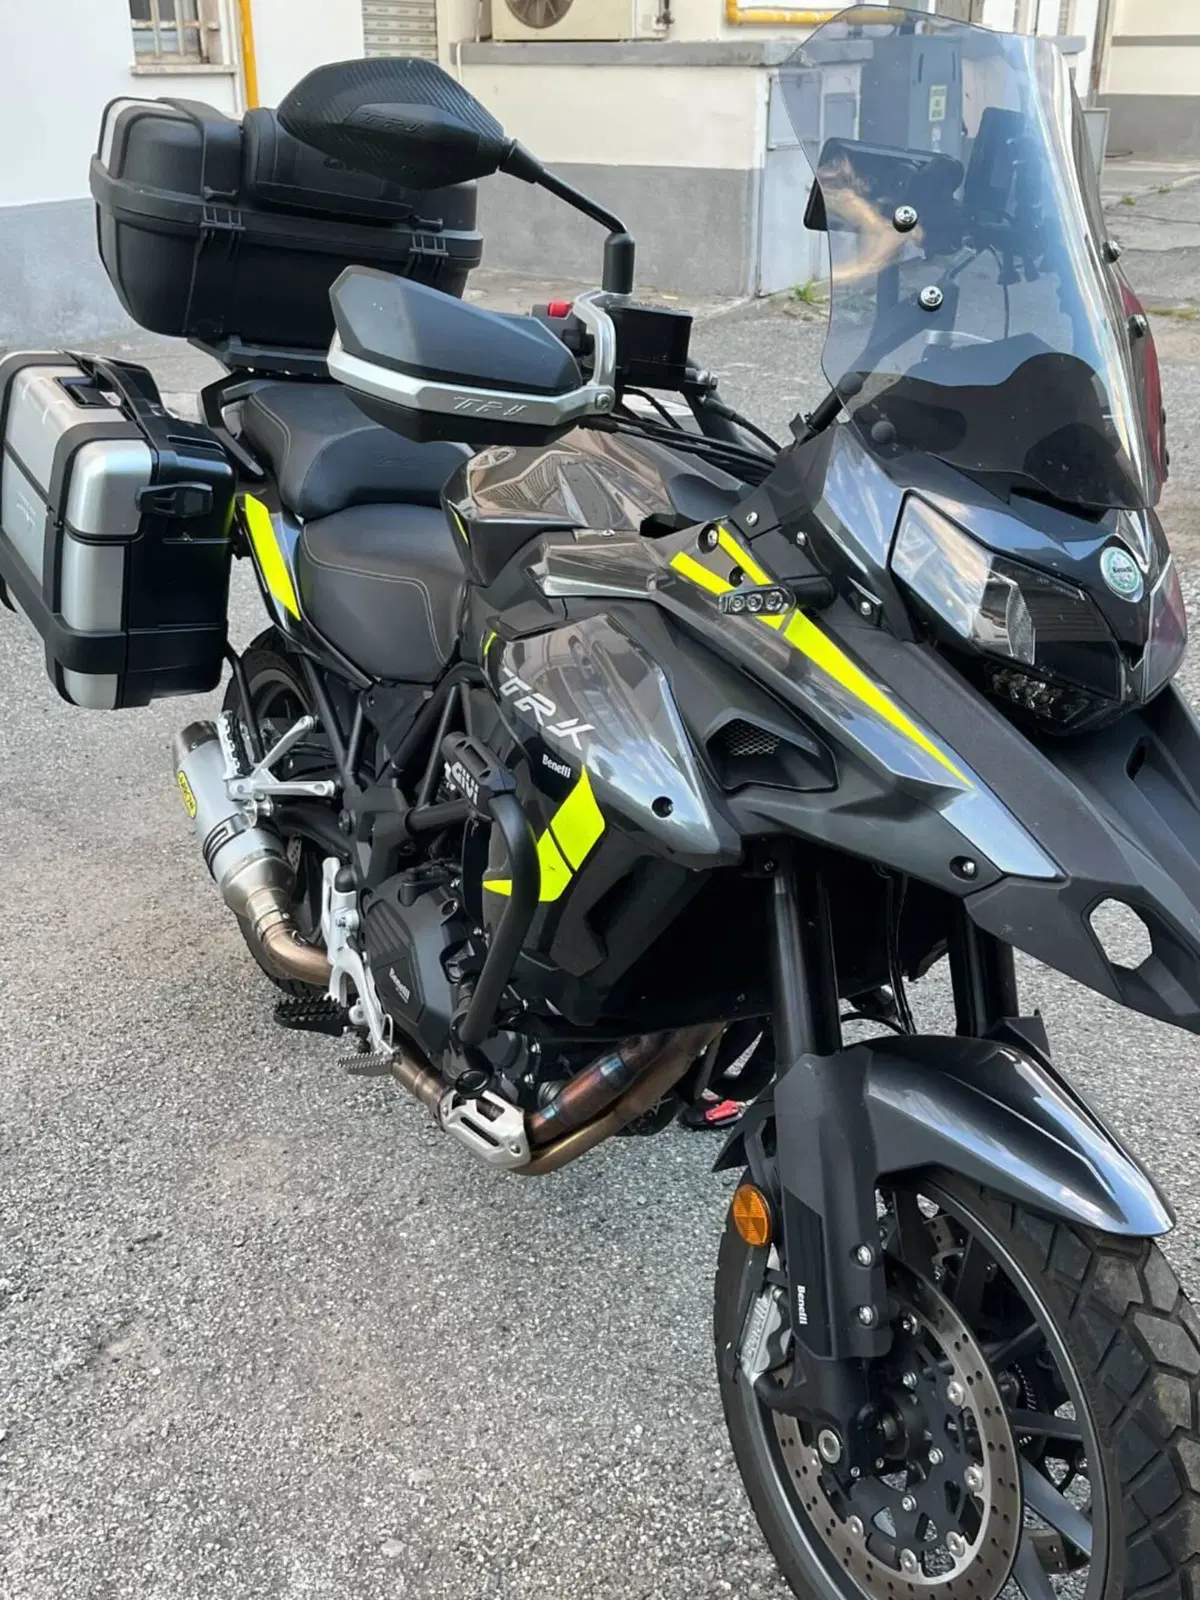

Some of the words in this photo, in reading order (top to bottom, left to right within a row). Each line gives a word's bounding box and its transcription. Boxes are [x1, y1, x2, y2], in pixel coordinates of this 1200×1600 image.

[500, 666, 596, 751] TRK
[452, 761, 480, 806] GIVI
[542, 754, 572, 779] Benelli
[797, 1284, 808, 1325] Benelli
